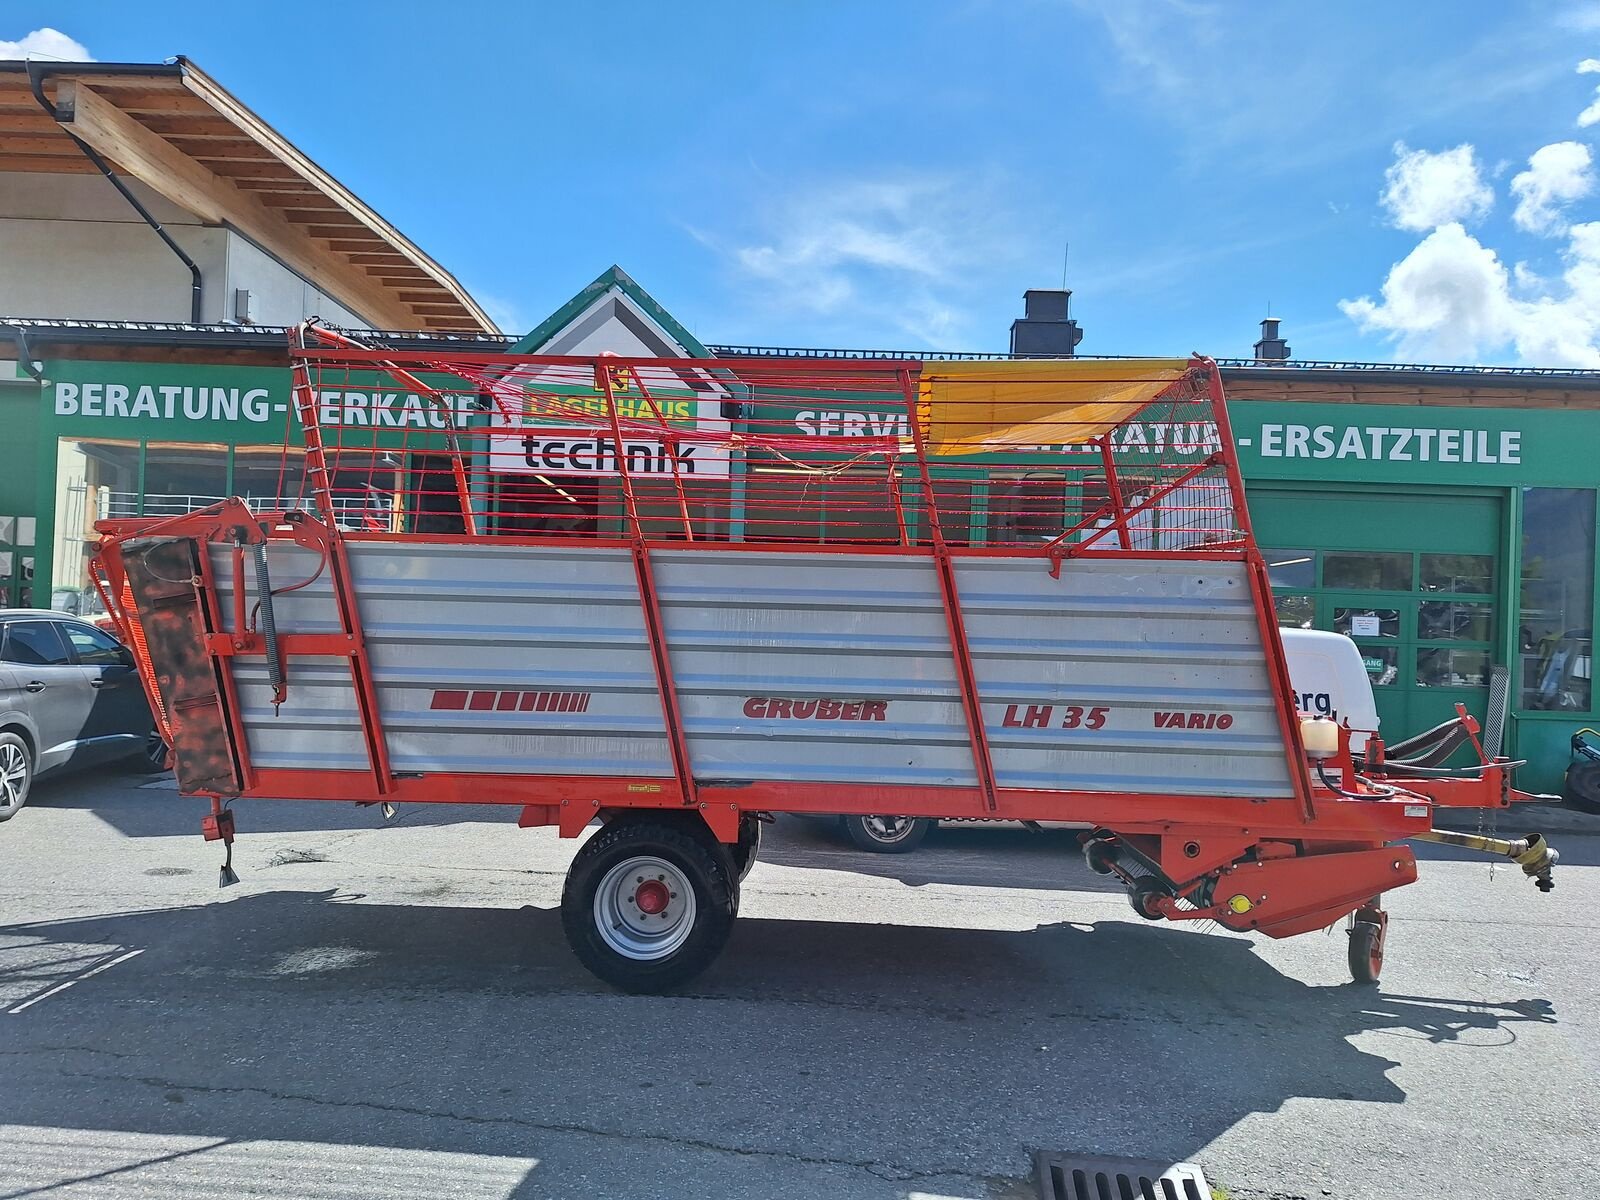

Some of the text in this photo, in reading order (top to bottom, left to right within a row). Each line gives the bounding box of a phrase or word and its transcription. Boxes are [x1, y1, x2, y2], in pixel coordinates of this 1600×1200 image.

[794, 410, 914, 437] SERVI
[521, 435, 696, 474] technik
[743, 697, 888, 721] GRUBER
[1002, 704, 1110, 730] LH 35
[1153, 711, 1234, 730] VARIO
